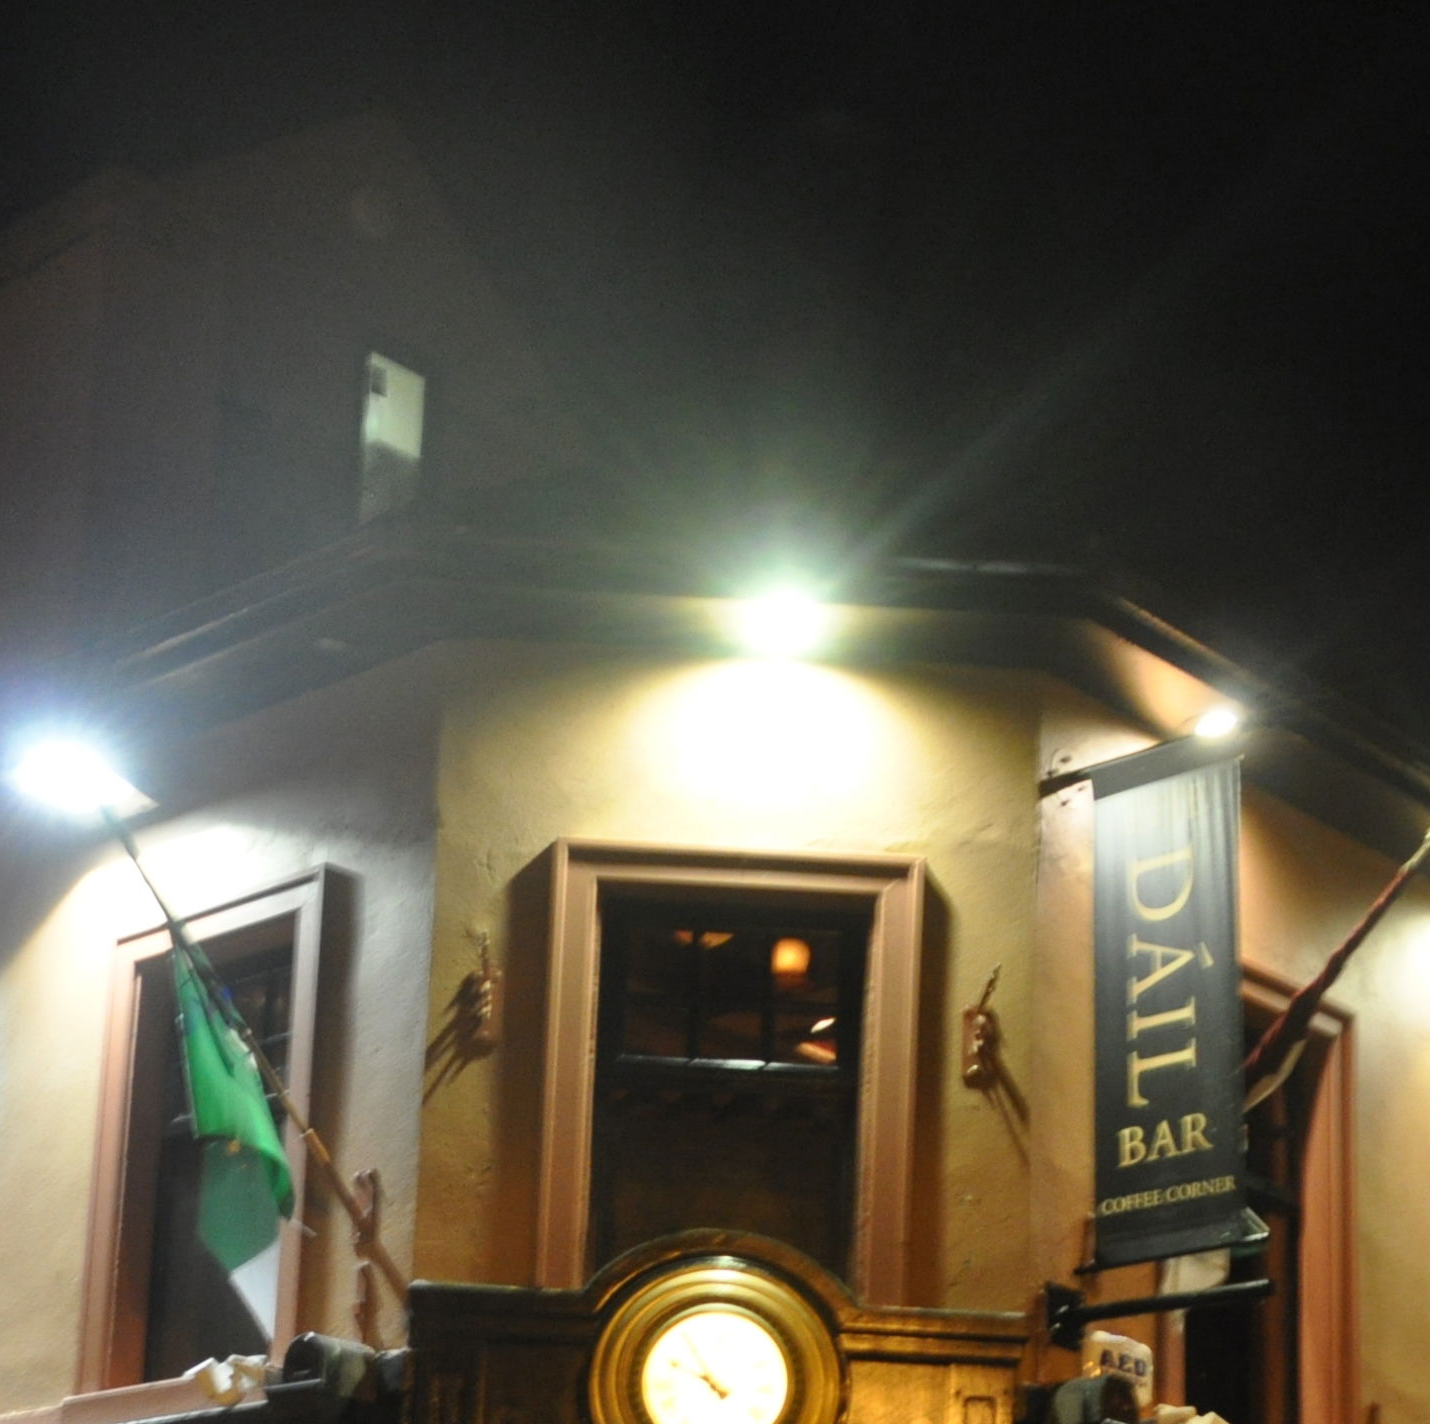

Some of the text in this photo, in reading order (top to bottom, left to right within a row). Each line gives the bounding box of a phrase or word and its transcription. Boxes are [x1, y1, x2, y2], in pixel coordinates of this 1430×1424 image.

[1126, 843, 1214, 1108] DÁIL
[1117, 1112, 1214, 1168] BAR
[1098, 1175, 1237, 1216] COFFEE CORNER
